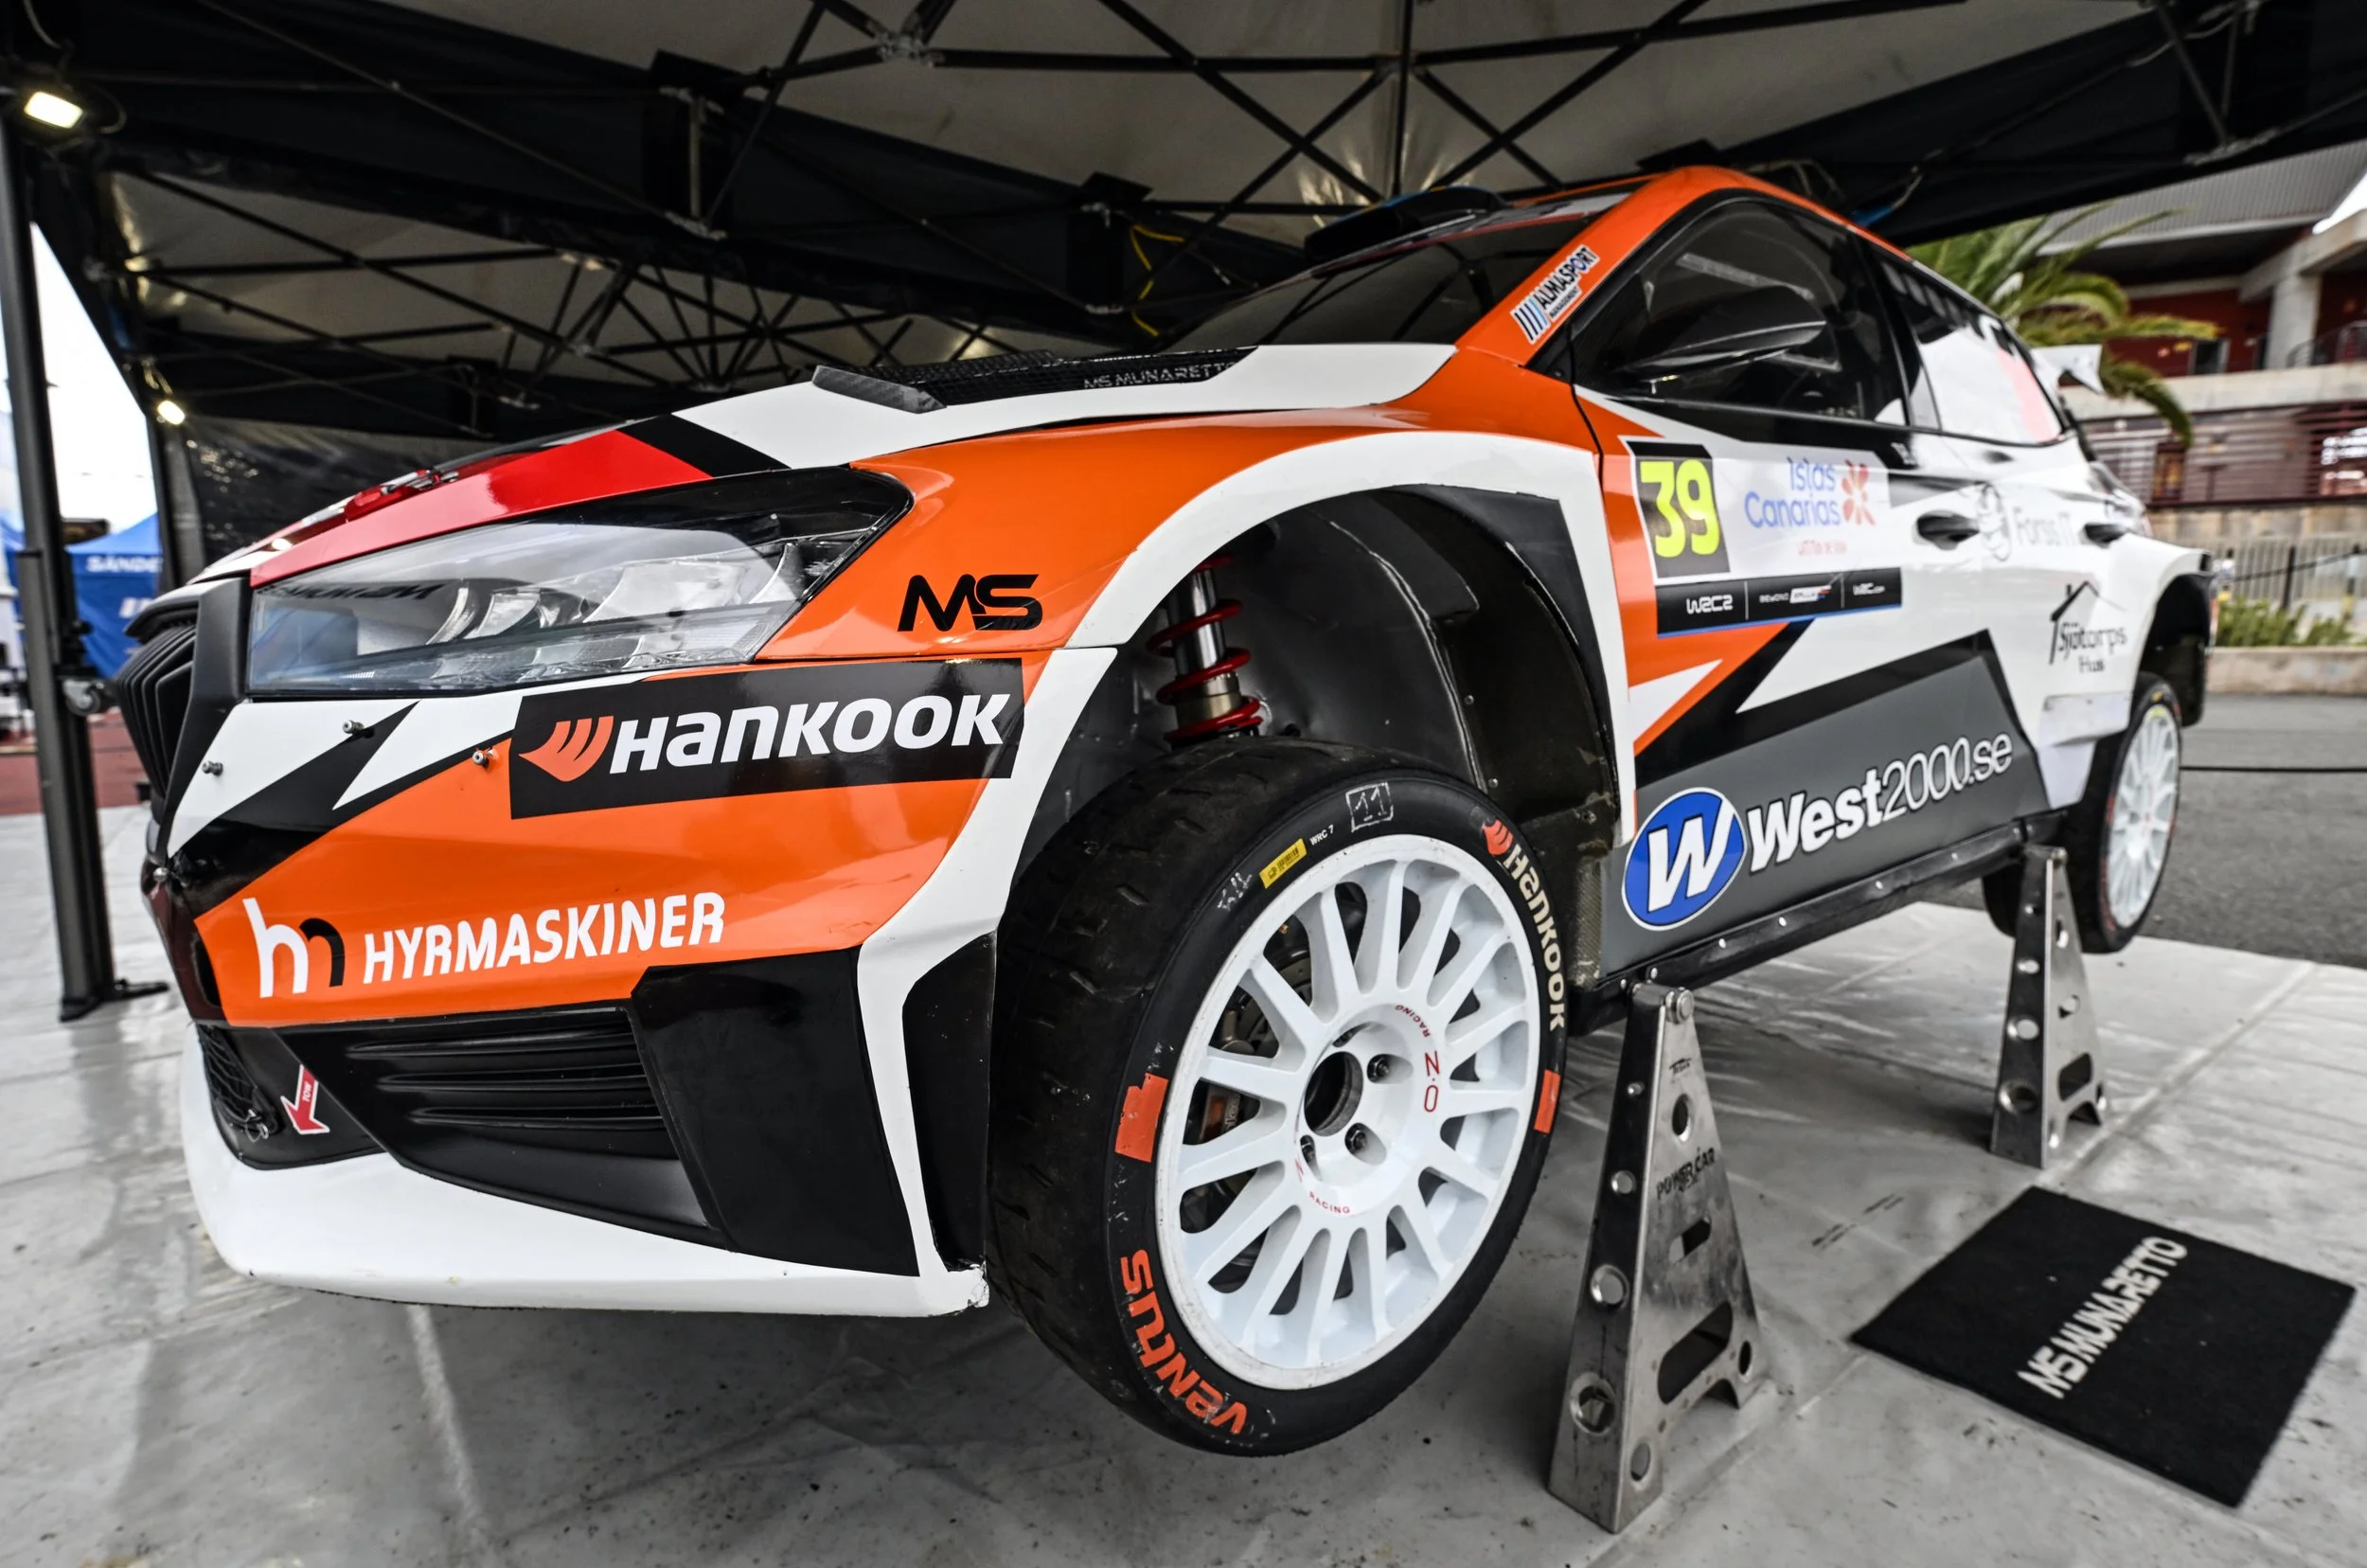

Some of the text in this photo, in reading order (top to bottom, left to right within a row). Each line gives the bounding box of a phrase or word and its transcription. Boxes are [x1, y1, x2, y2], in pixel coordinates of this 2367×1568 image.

[1533, 247, 1597, 310] ALMASPORT
[1084, 374, 1112, 389] MS
[1787, 455, 1836, 492] Islas
[1640, 458, 1720, 558] 39
[1744, 490, 1842, 529] Canarias
[898, 573, 1042, 633] MS
[1746, 732, 2013, 873] West2000.se
[1309, 824, 1334, 846] WRC 7
[364, 891, 725, 984] HYRMASKINER
[1395, 1004, 1431, 1038] RACING
[1308, 1190, 1351, 1215] RACING
[2017, 1236, 2188, 1399] MS MUNARETTO
